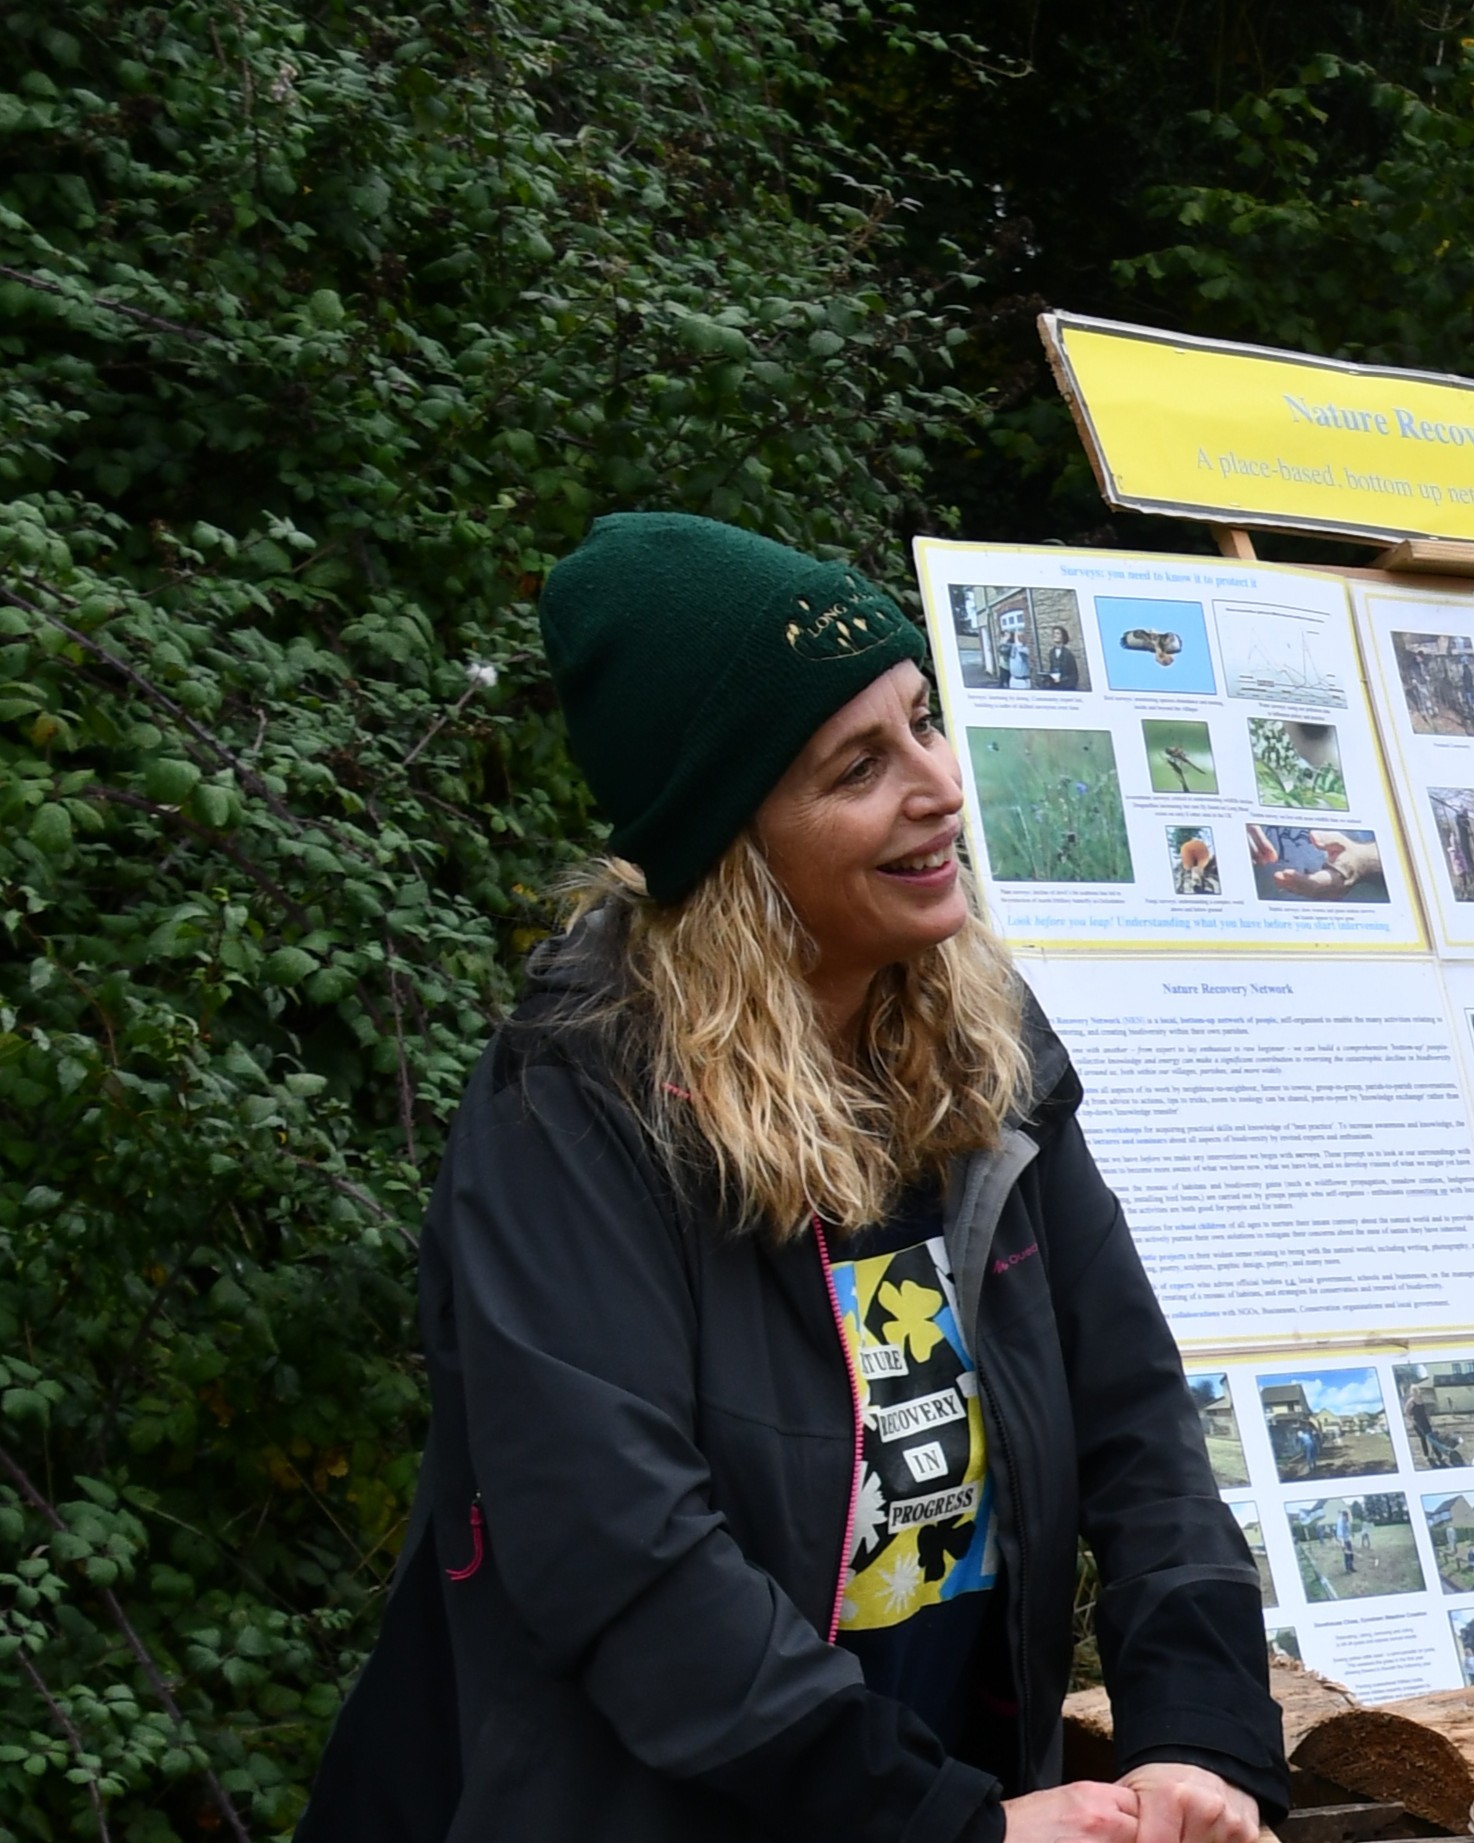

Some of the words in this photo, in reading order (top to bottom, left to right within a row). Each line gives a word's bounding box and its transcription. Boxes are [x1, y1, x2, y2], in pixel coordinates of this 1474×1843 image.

[1284, 392, 1388, 435] Nature
[1196, 449, 1212, 470] A
[1345, 470, 1411, 497] bottom
[1417, 485, 1441, 507] up
[1107, 570, 1125, 580] you
[1127, 571, 1150, 580] need
[1153, 571, 1163, 581] to
[1165, 572, 1191, 583] know
[1194, 574, 1201, 584] it
[1203, 575, 1213, 585] to
[1215, 577, 1248, 588] protect
[1250, 578, 1256, 588] it
[807, 603, 848, 638] LONG
[1007, 915, 1031, 925] Look
[1034, 915, 1066, 926] before
[1069, 918, 1087, 928] you
[1116, 917, 1189, 930] Understanding
[1193, 918, 1216, 928] what
[1219, 921, 1237, 930] you
[1240, 918, 1261, 928] have
[1264, 919, 1292, 929] before
[1295, 922, 1312, 931] you
[1314, 919, 1334, 929] start
[1338, 920, 1389, 932] intervening
[1162, 982, 1198, 993] Nature
[1200, 983, 1247, 996] Recovery
[1250, 984, 1293, 994] Network
[860, 1350, 903, 1374] TURE
[880, 1395, 958, 1436] RECOVERY
[912, 1448, 939, 1475] IN
[892, 1486, 974, 1527] PROGRESS
